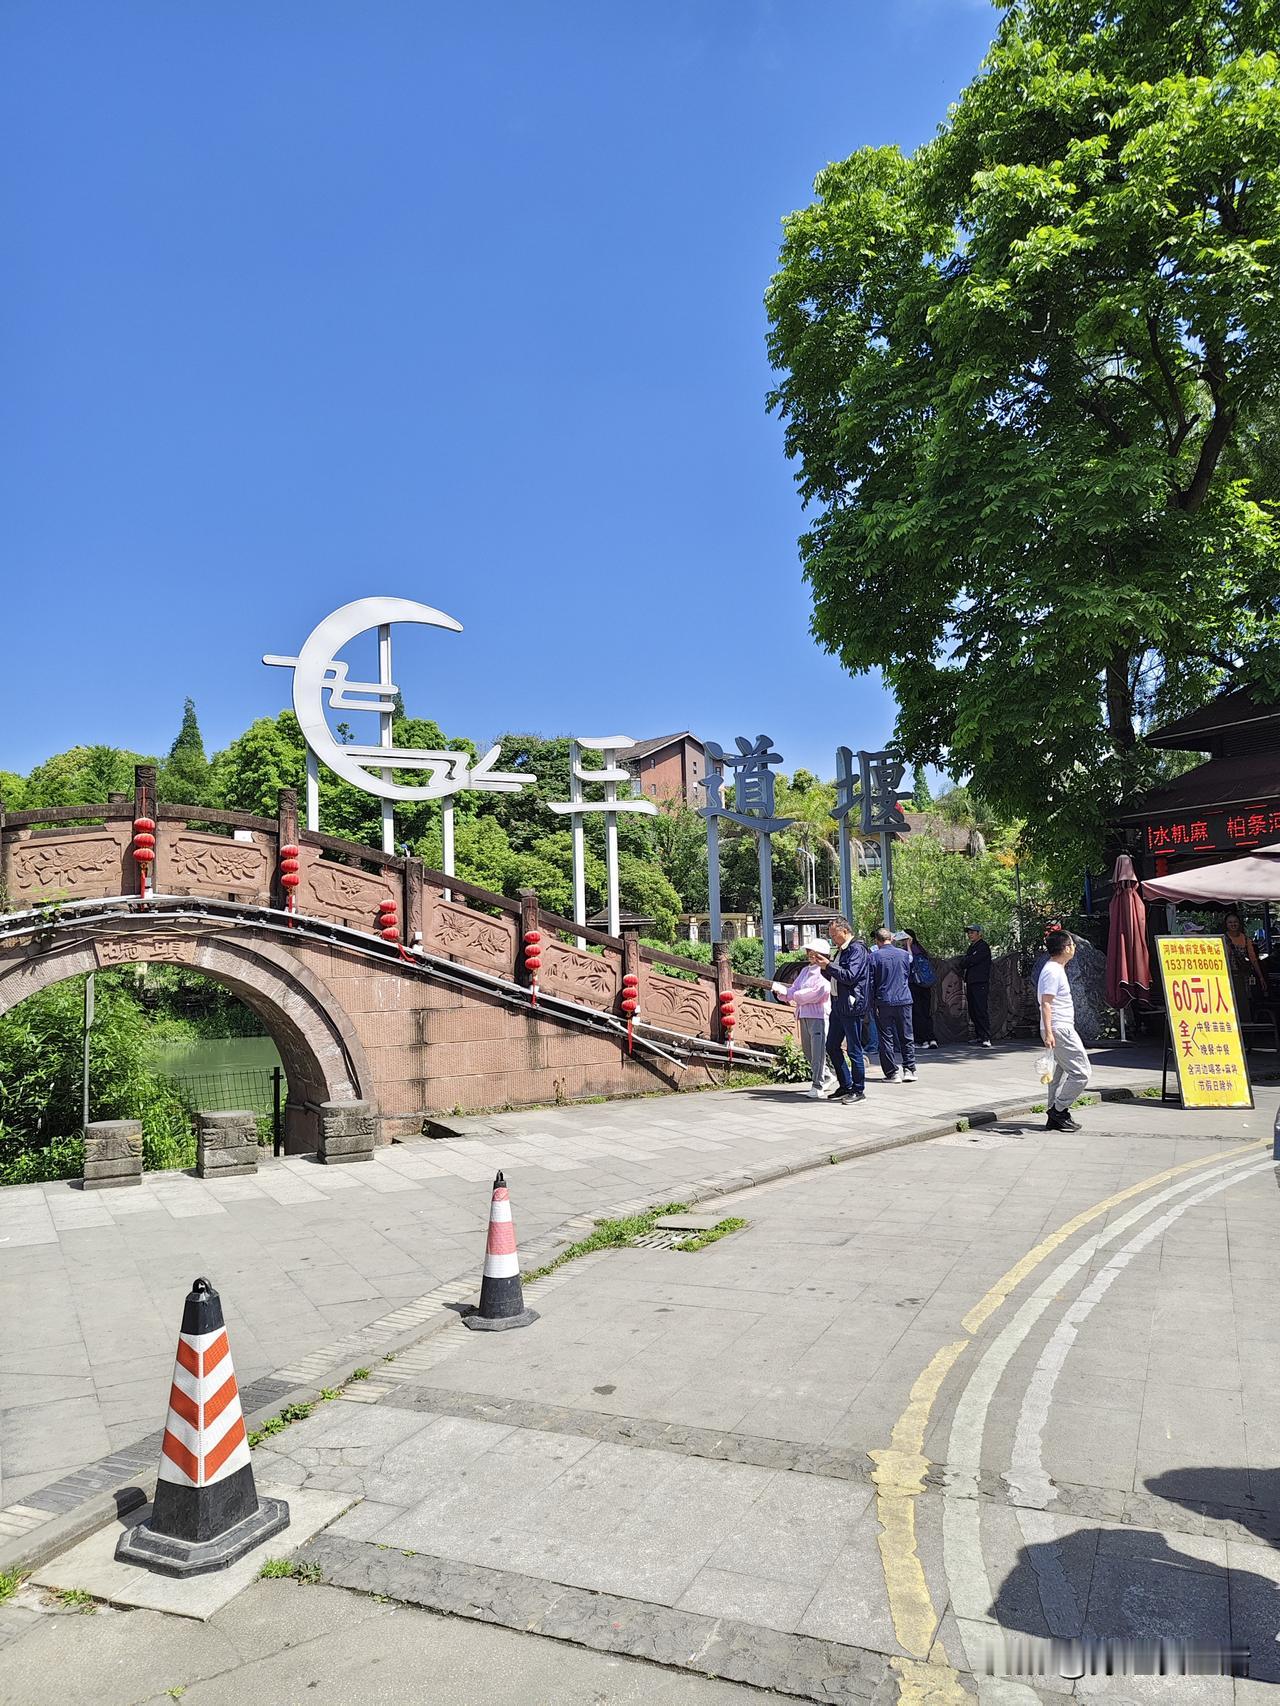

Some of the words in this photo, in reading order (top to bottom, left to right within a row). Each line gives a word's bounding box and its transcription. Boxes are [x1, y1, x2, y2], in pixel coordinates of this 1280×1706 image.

[547, 734, 912, 834] 三道堰
[1148, 820, 1208, 849] 水机麻
[1165, 959, 1223, 970] 15378186067
[1172, 976, 1229, 1014] 60元/人
[1178, 1020, 1194, 1057] 全天
